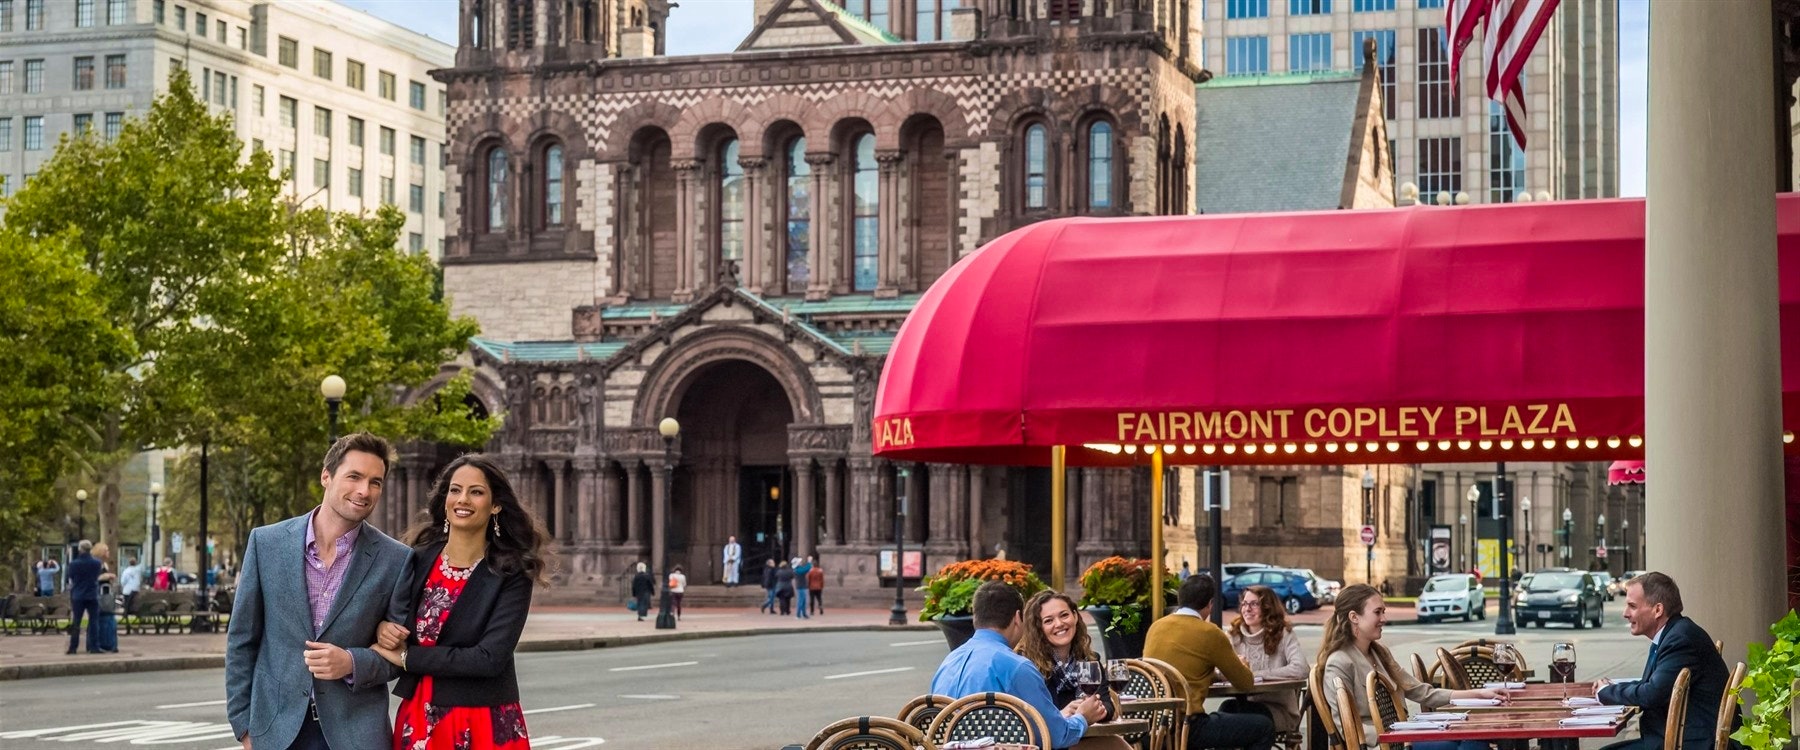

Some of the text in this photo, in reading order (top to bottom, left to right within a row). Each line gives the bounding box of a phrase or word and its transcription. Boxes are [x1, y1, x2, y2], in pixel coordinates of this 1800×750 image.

[1117, 403, 1577, 441] FAIRMONT COPLEY PLAZA
